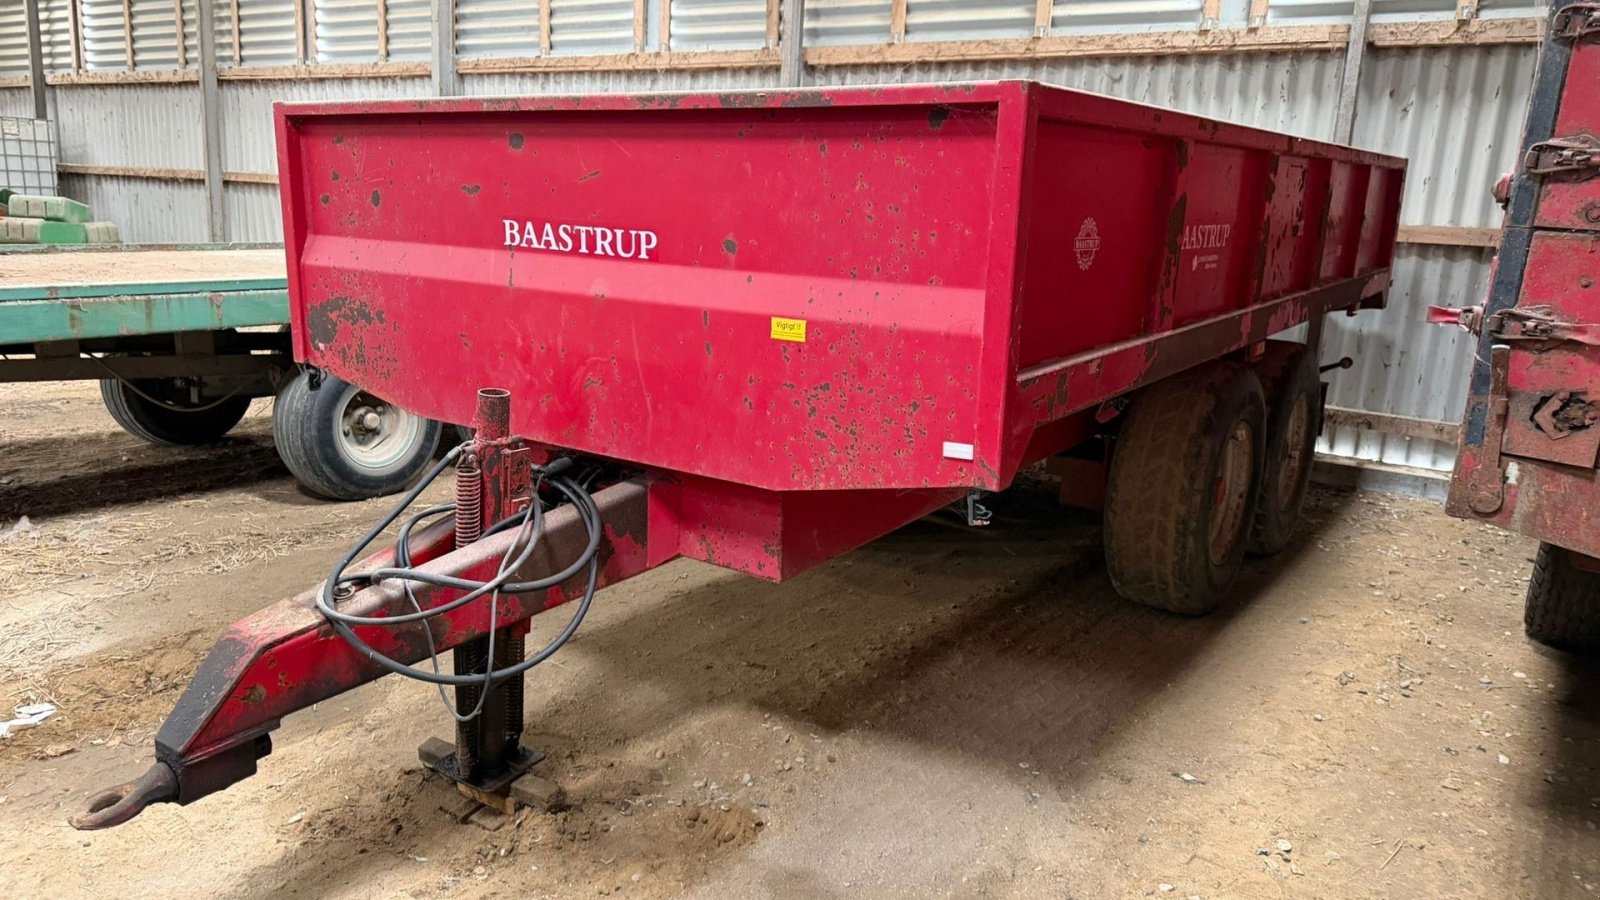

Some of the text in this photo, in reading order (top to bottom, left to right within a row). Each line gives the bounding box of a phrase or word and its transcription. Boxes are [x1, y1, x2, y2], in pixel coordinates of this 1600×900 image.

[502, 218, 658, 260] BAASTRUP
[1075, 239, 1099, 250] BAASTRUP
[1180, 223, 1230, 250] AASTRUP
[776, 321, 796, 331] Vigtigt
